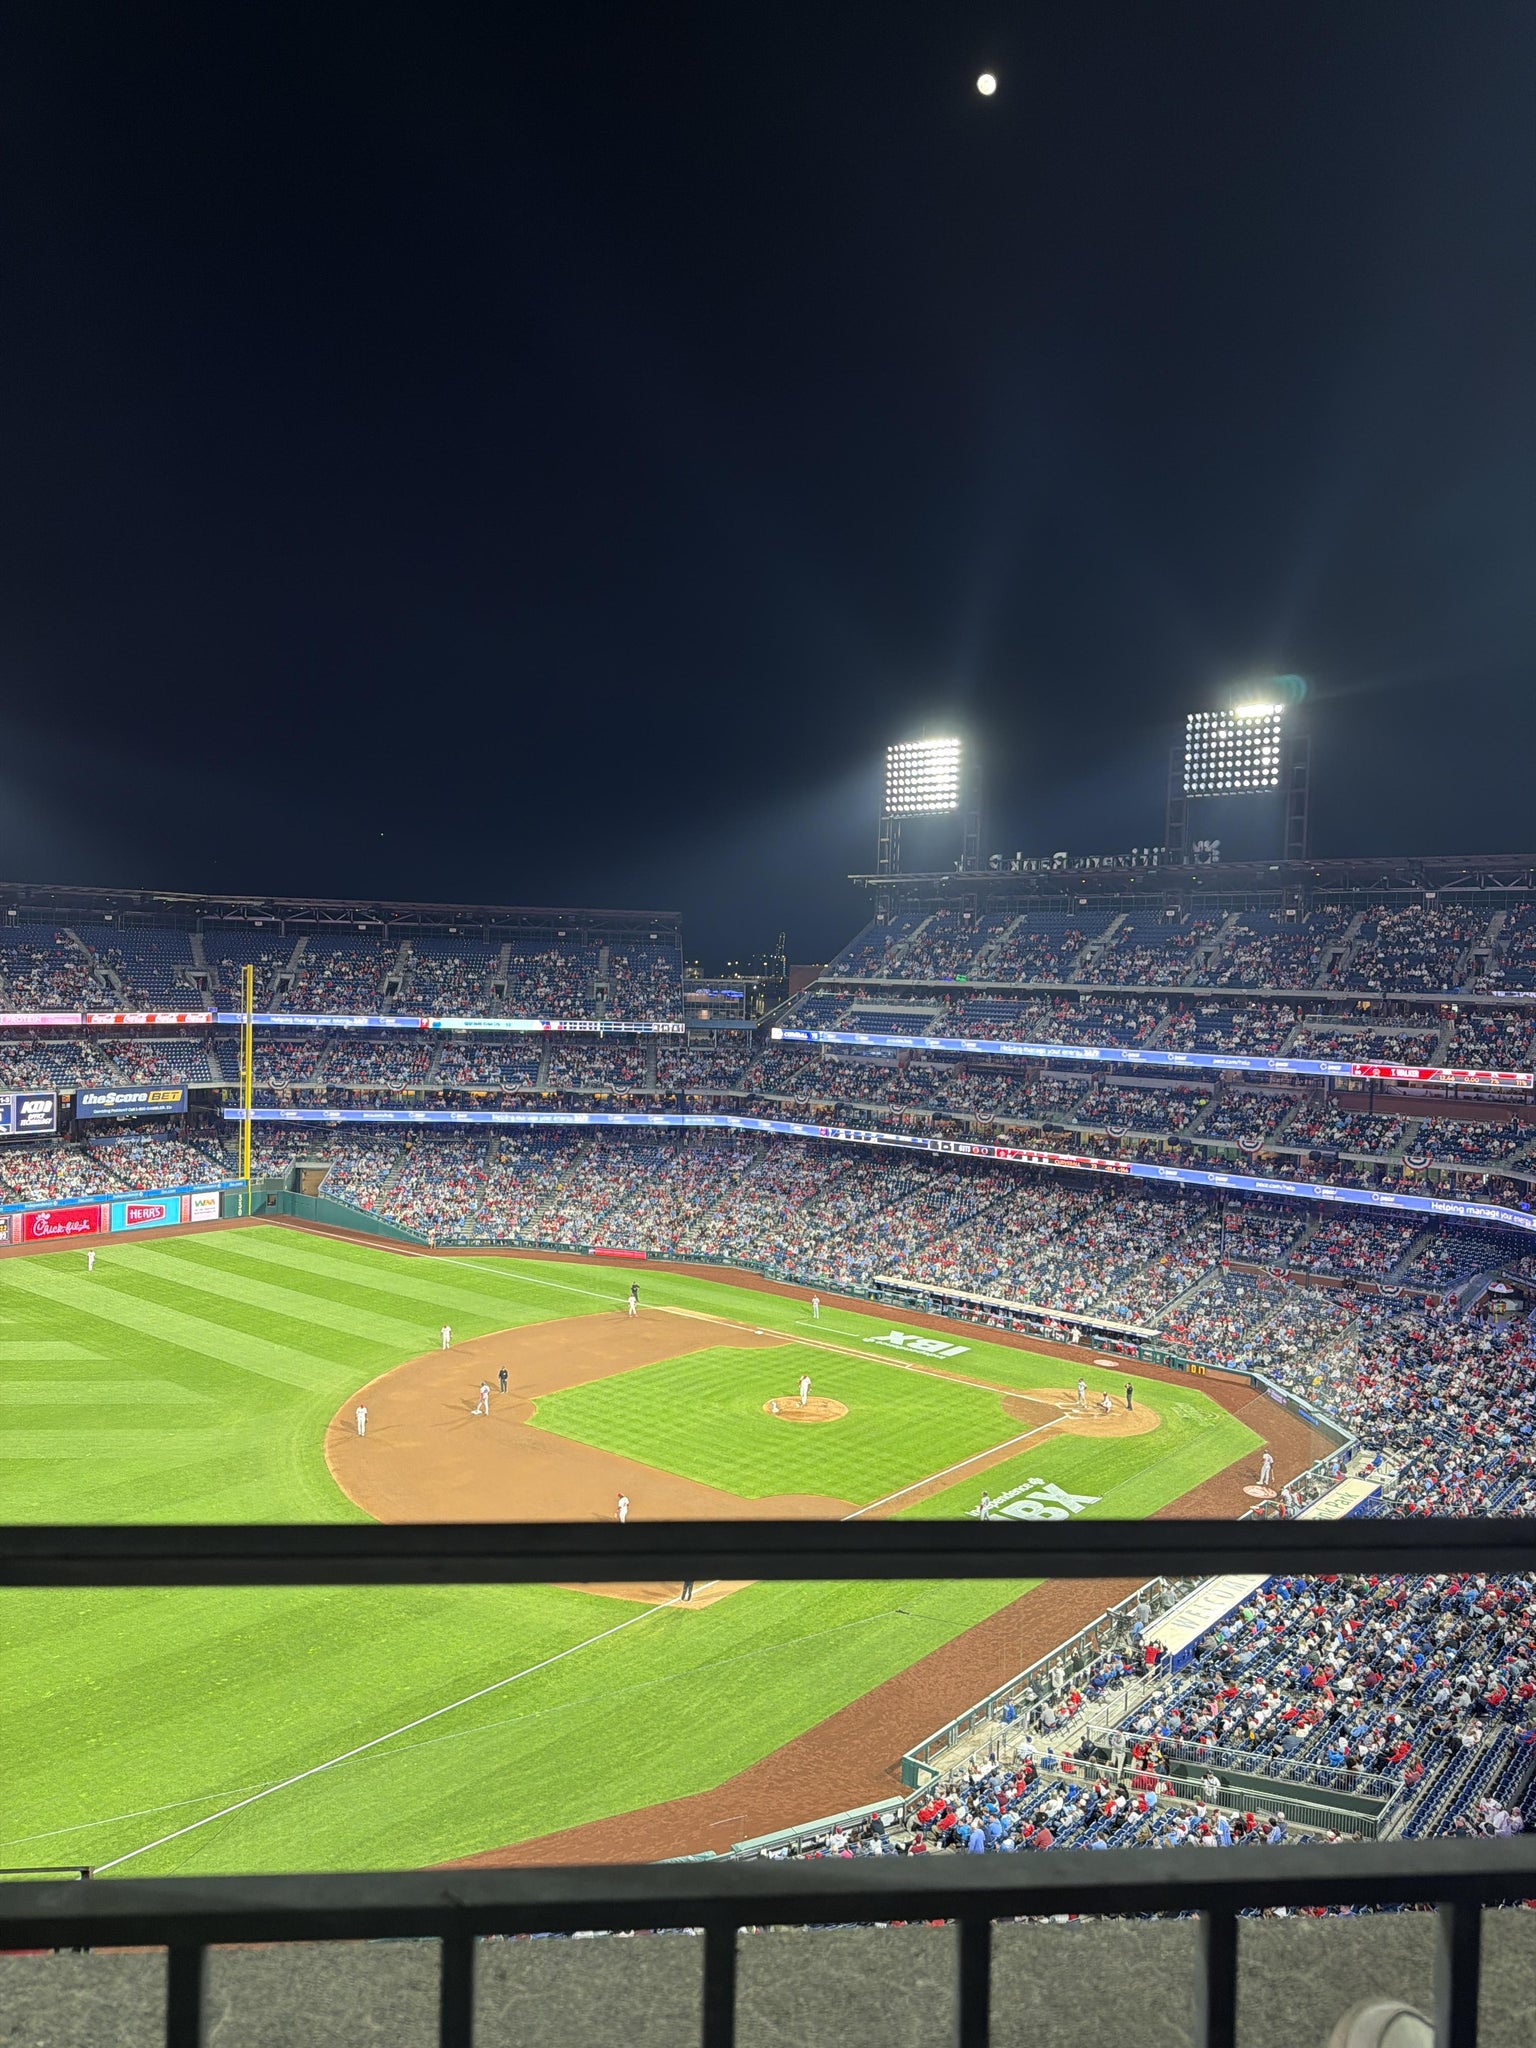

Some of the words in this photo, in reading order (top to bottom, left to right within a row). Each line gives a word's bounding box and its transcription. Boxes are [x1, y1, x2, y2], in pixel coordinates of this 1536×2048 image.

[82, 1092, 148, 1106] theScore
[152, 1090, 180, 1101] BET
[1431, 1202, 1465, 1214] Helping
[1465, 1206, 1500, 1219] manage
[1324, 1492, 1361, 1510] Park
